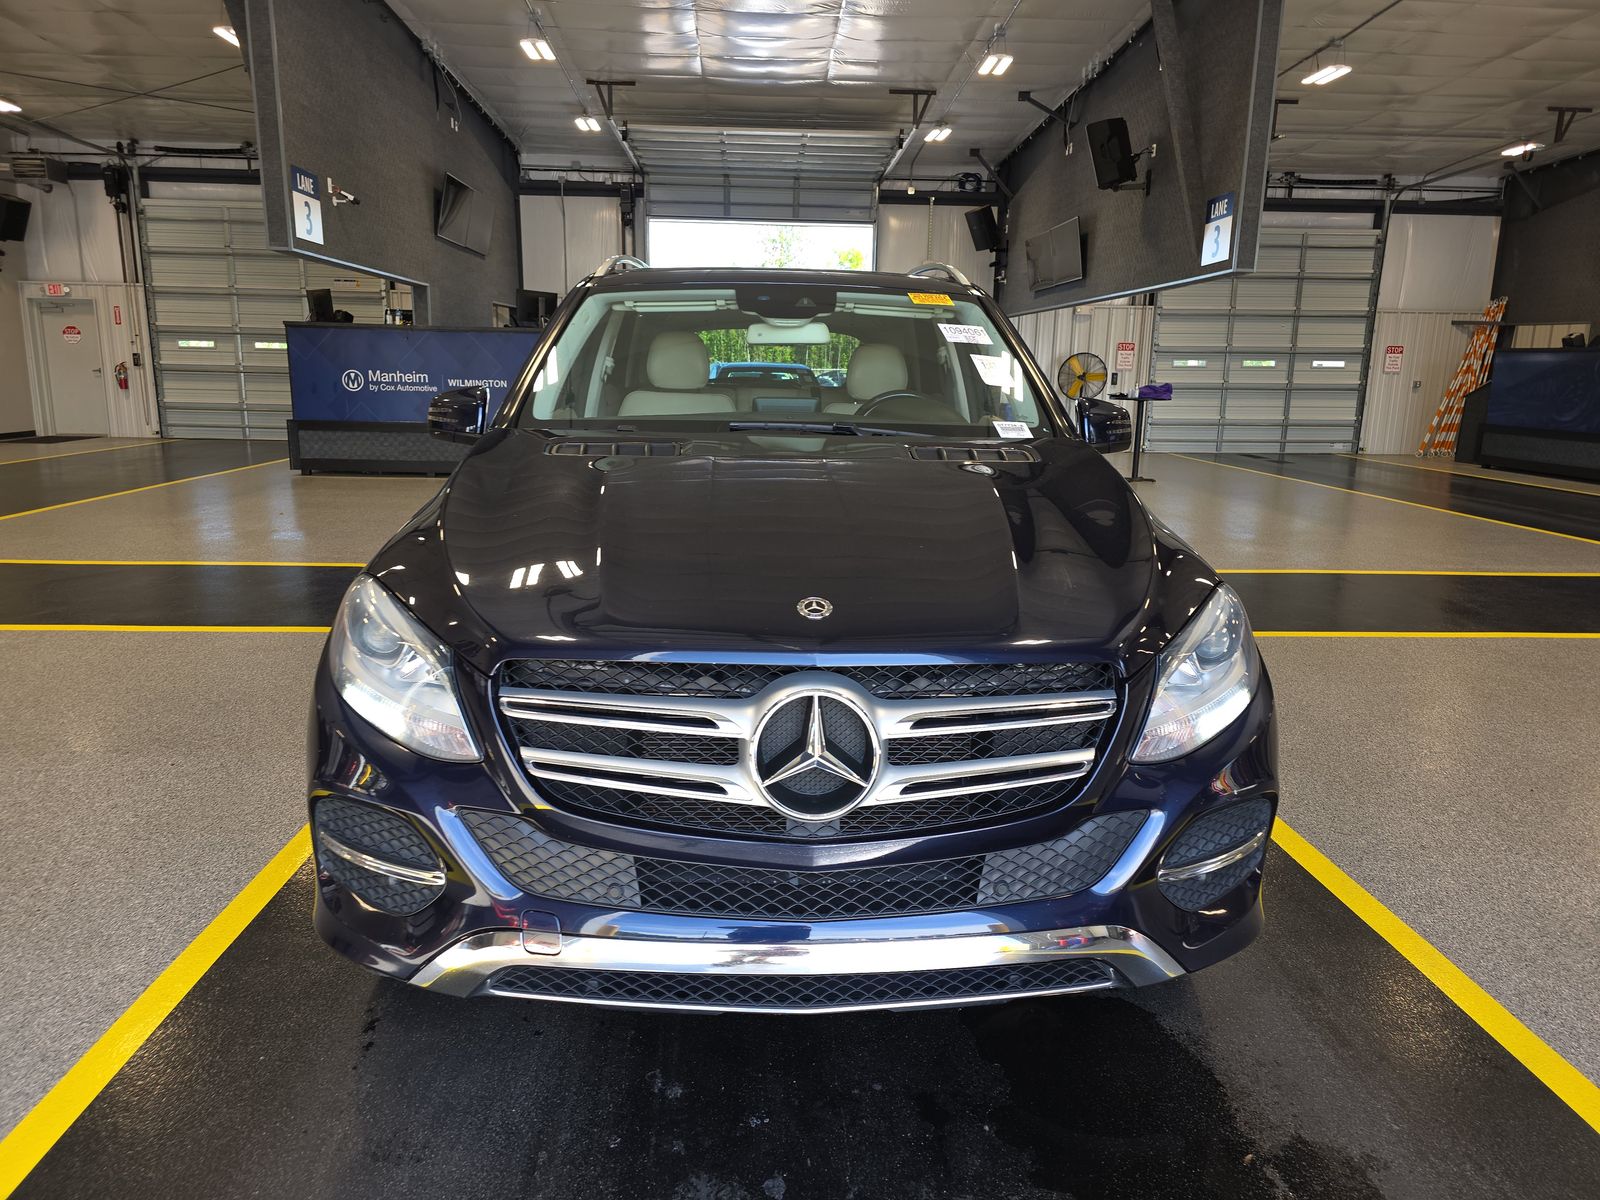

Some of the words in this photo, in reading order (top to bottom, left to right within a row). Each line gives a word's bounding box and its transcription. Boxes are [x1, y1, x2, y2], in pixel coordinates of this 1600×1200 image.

[296, 172, 315, 195] LANE
[1211, 199, 1229, 219] LANE
[304, 200, 313, 236] 3
[1211, 224, 1221, 259] 3
[1118, 343, 1135, 351] STOP
[1387, 346, 1403, 354] STOP
[368, 370, 429, 383] Manheim
[448, 378, 508, 388] WILMINGTON
[369, 384, 378, 393] by
[380, 384, 395, 392] Cox
[396, 384, 438, 392] Automotive
